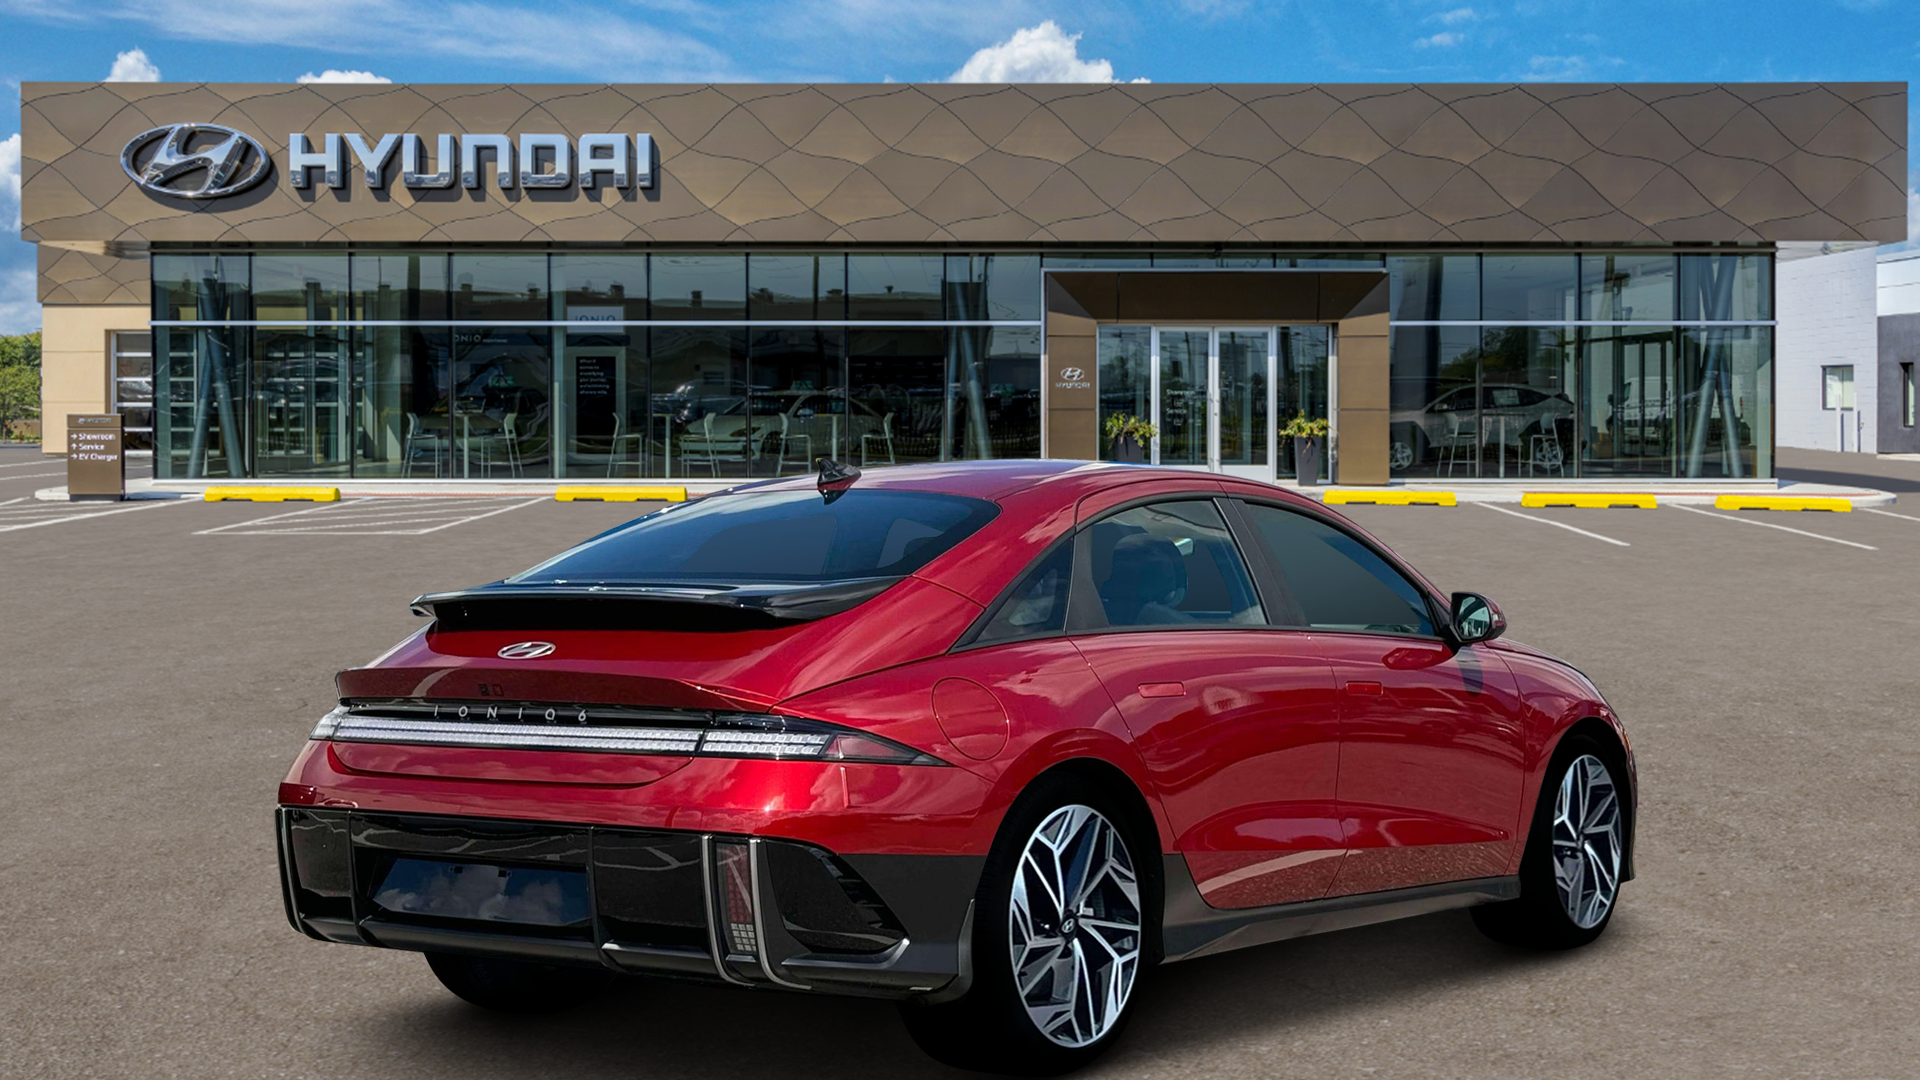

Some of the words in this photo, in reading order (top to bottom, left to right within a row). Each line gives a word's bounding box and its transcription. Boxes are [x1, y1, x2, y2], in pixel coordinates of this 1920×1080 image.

[289, 133, 654, 188] HYUNDAI
[78, 442, 105, 450] Service
[90, 453, 118, 462] Charger
[434, 704, 556, 720] IONIQ
[578, 709, 587, 722] 6
